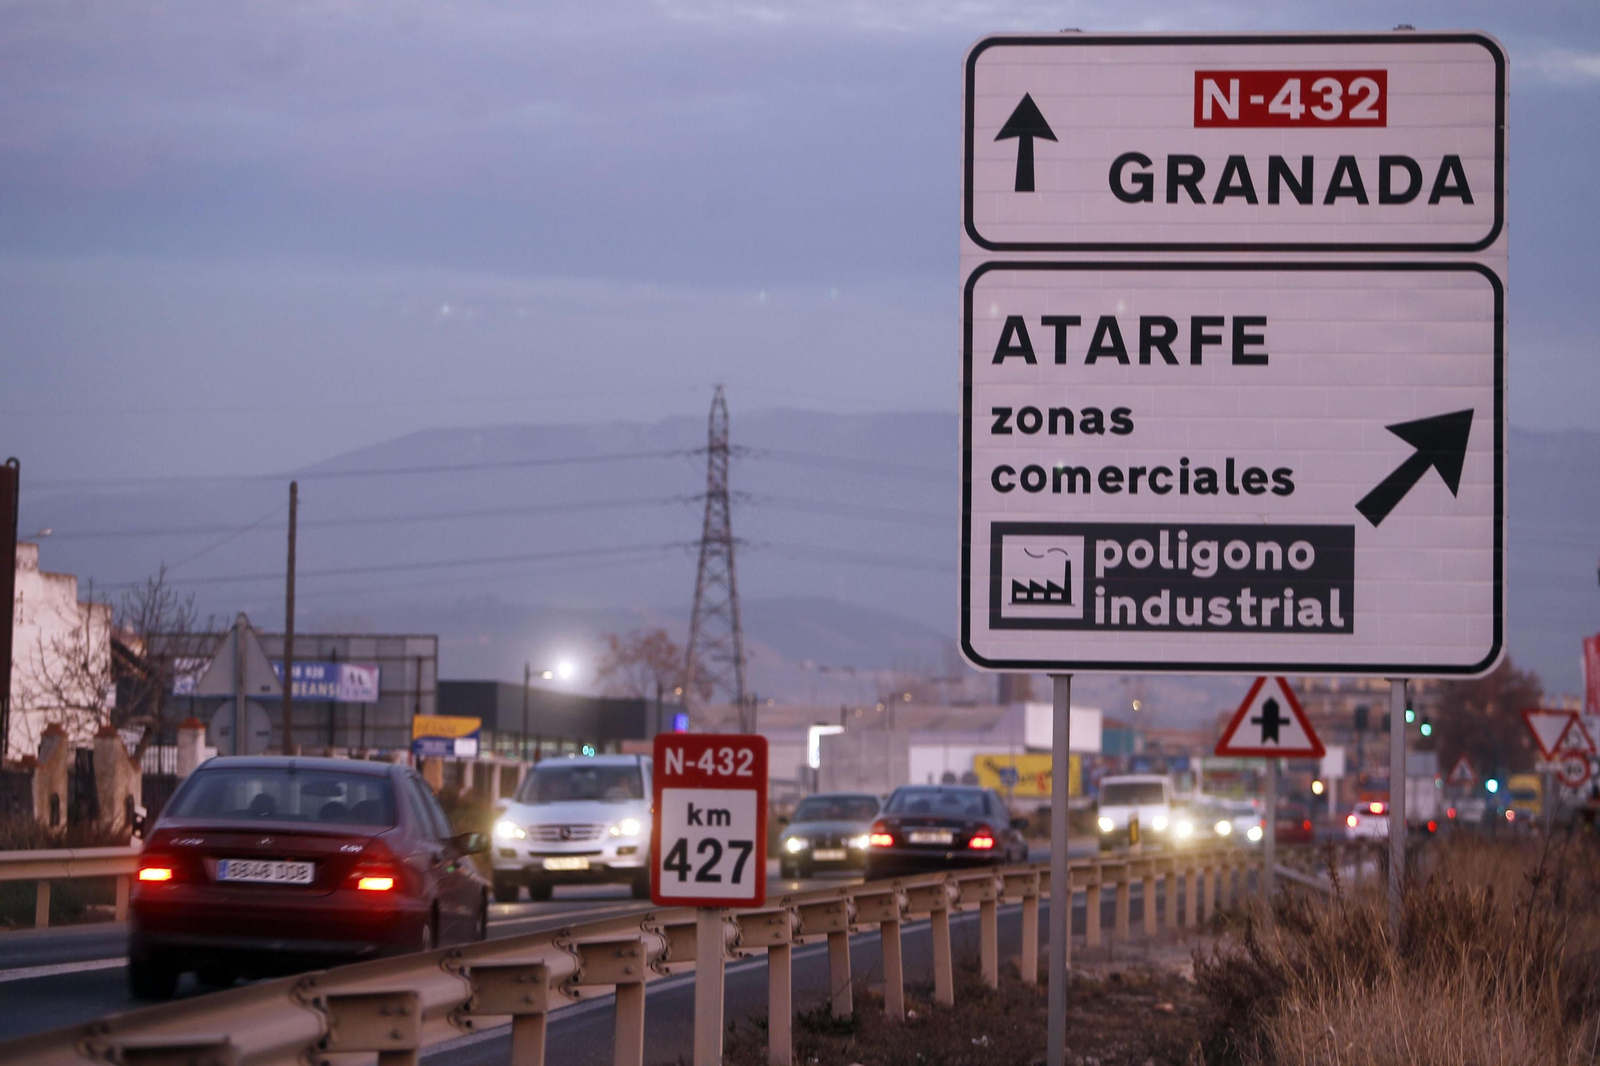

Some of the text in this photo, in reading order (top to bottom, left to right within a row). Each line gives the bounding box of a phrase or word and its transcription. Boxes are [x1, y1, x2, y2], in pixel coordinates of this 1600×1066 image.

[1201, 77, 1380, 120] N-432
[1108, 151, 1475, 206] GRANADA
[991, 315, 1269, 366] ATARFE
[990, 406, 1135, 436] zonas
[990, 456, 1296, 497] comerciales
[1095, 530, 1316, 579] poligono
[1095, 586, 1345, 628] industrial
[664, 747, 754, 777] N-432
[687, 802, 732, 827] km
[663, 837, 754, 885] 427
